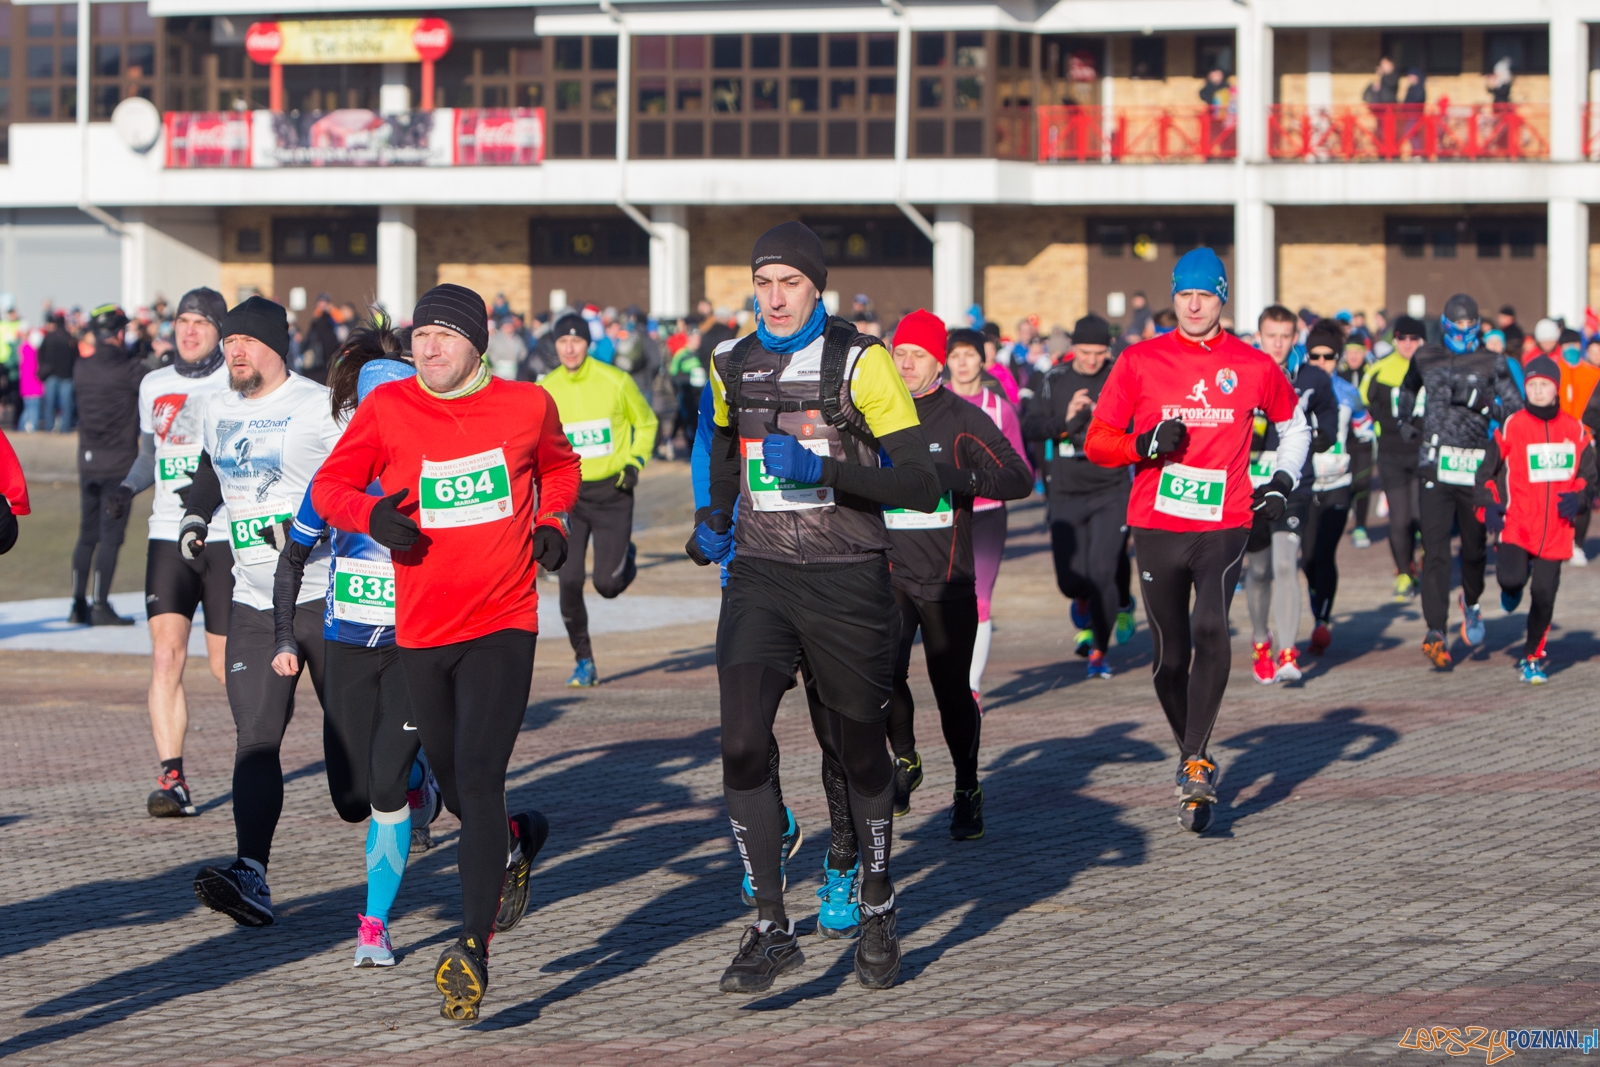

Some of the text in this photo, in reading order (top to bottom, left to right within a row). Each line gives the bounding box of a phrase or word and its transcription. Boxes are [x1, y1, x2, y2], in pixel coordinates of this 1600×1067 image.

[573, 429, 604, 445] 833
[164, 456, 199, 476] 595
[1448, 455, 1477, 471] 658
[435, 470, 494, 502] 694
[1170, 477, 1211, 500] 621
[454, 498, 480, 507] MARIAN
[348, 575, 395, 602] 838
[358, 598, 386, 607] DOMINIKA
[866, 818, 890, 873] Kalenji
